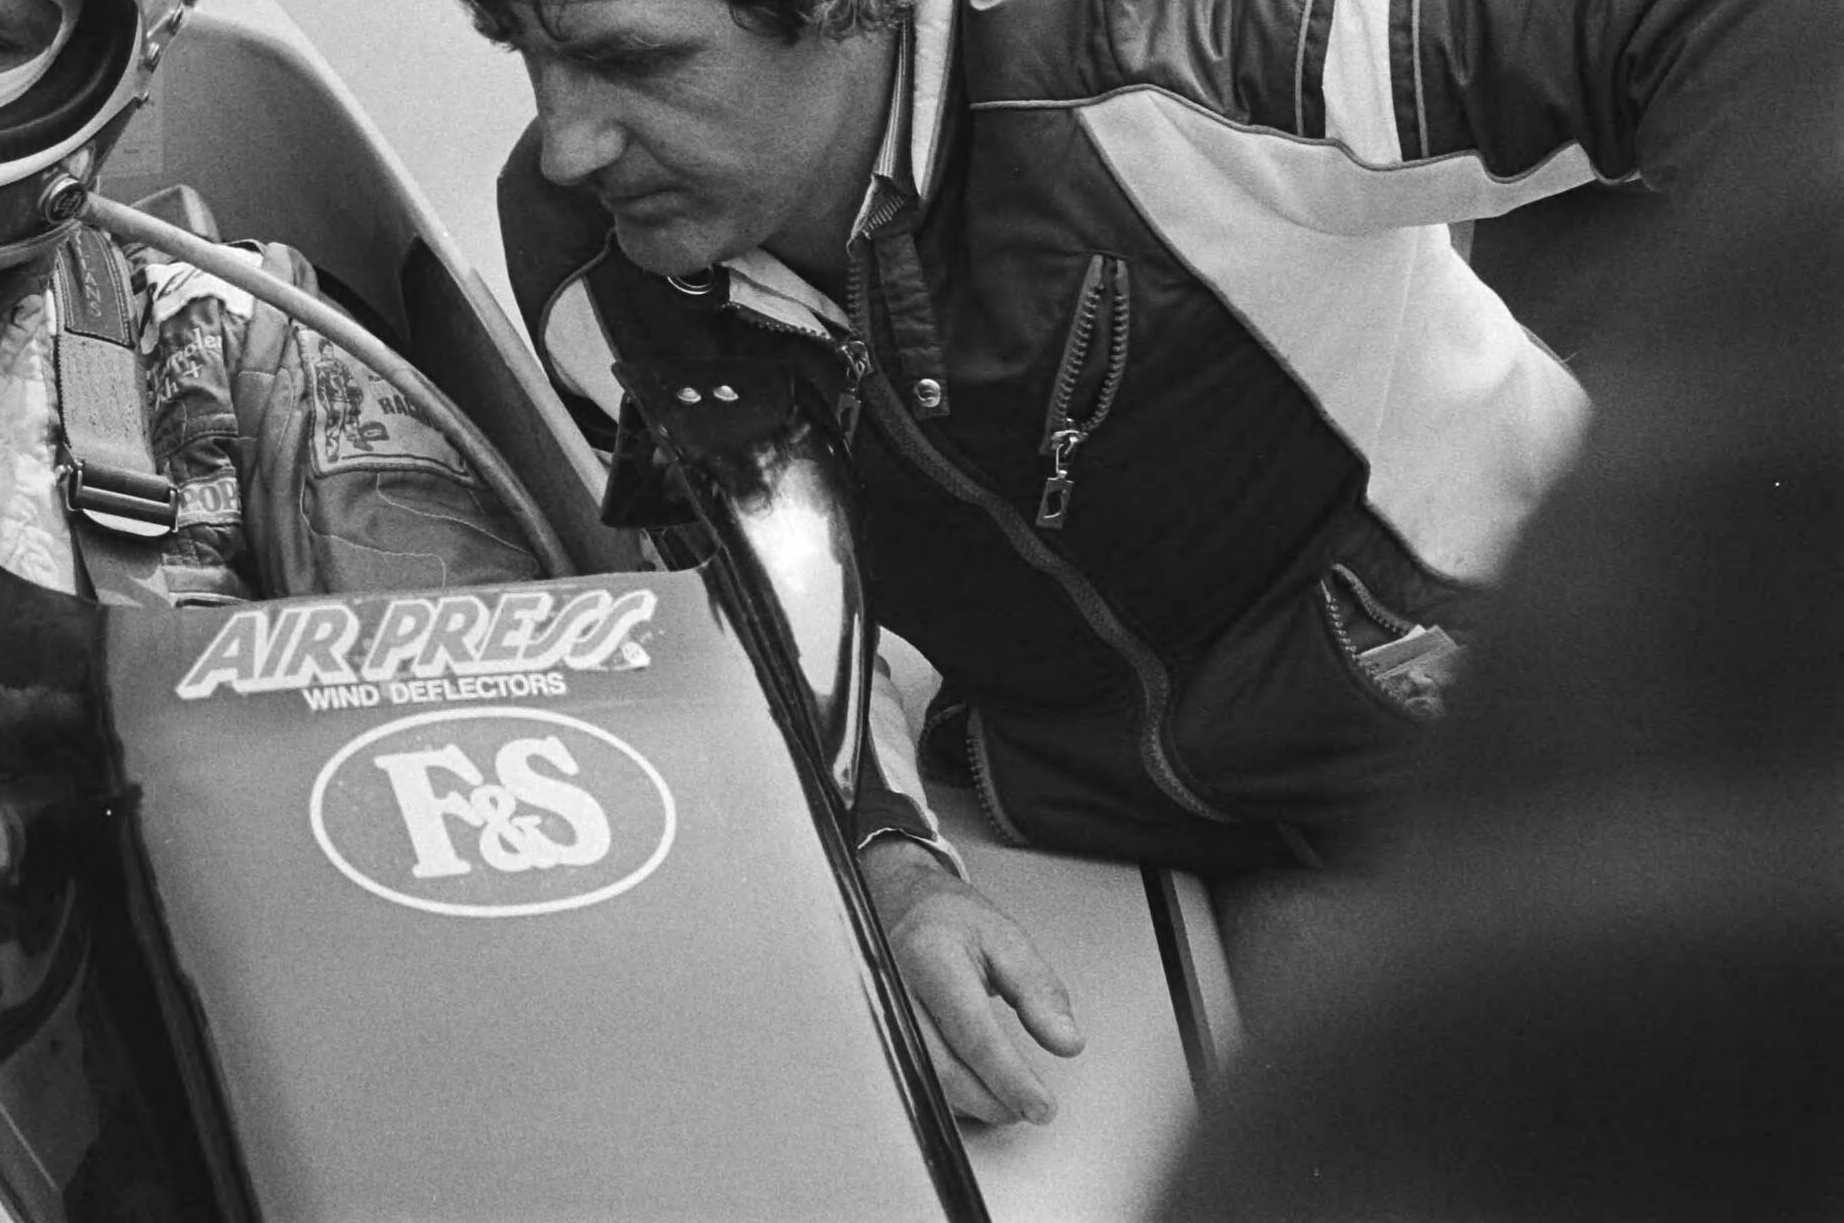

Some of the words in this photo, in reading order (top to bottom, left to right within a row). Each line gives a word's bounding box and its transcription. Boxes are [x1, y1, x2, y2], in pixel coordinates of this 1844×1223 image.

[176, 606, 360, 700] AIR
[363, 590, 659, 682] PRESS
[302, 684, 380, 711] WIND
[388, 672, 568, 706] DEFLECTORS
[374, 735, 613, 879] F&S
